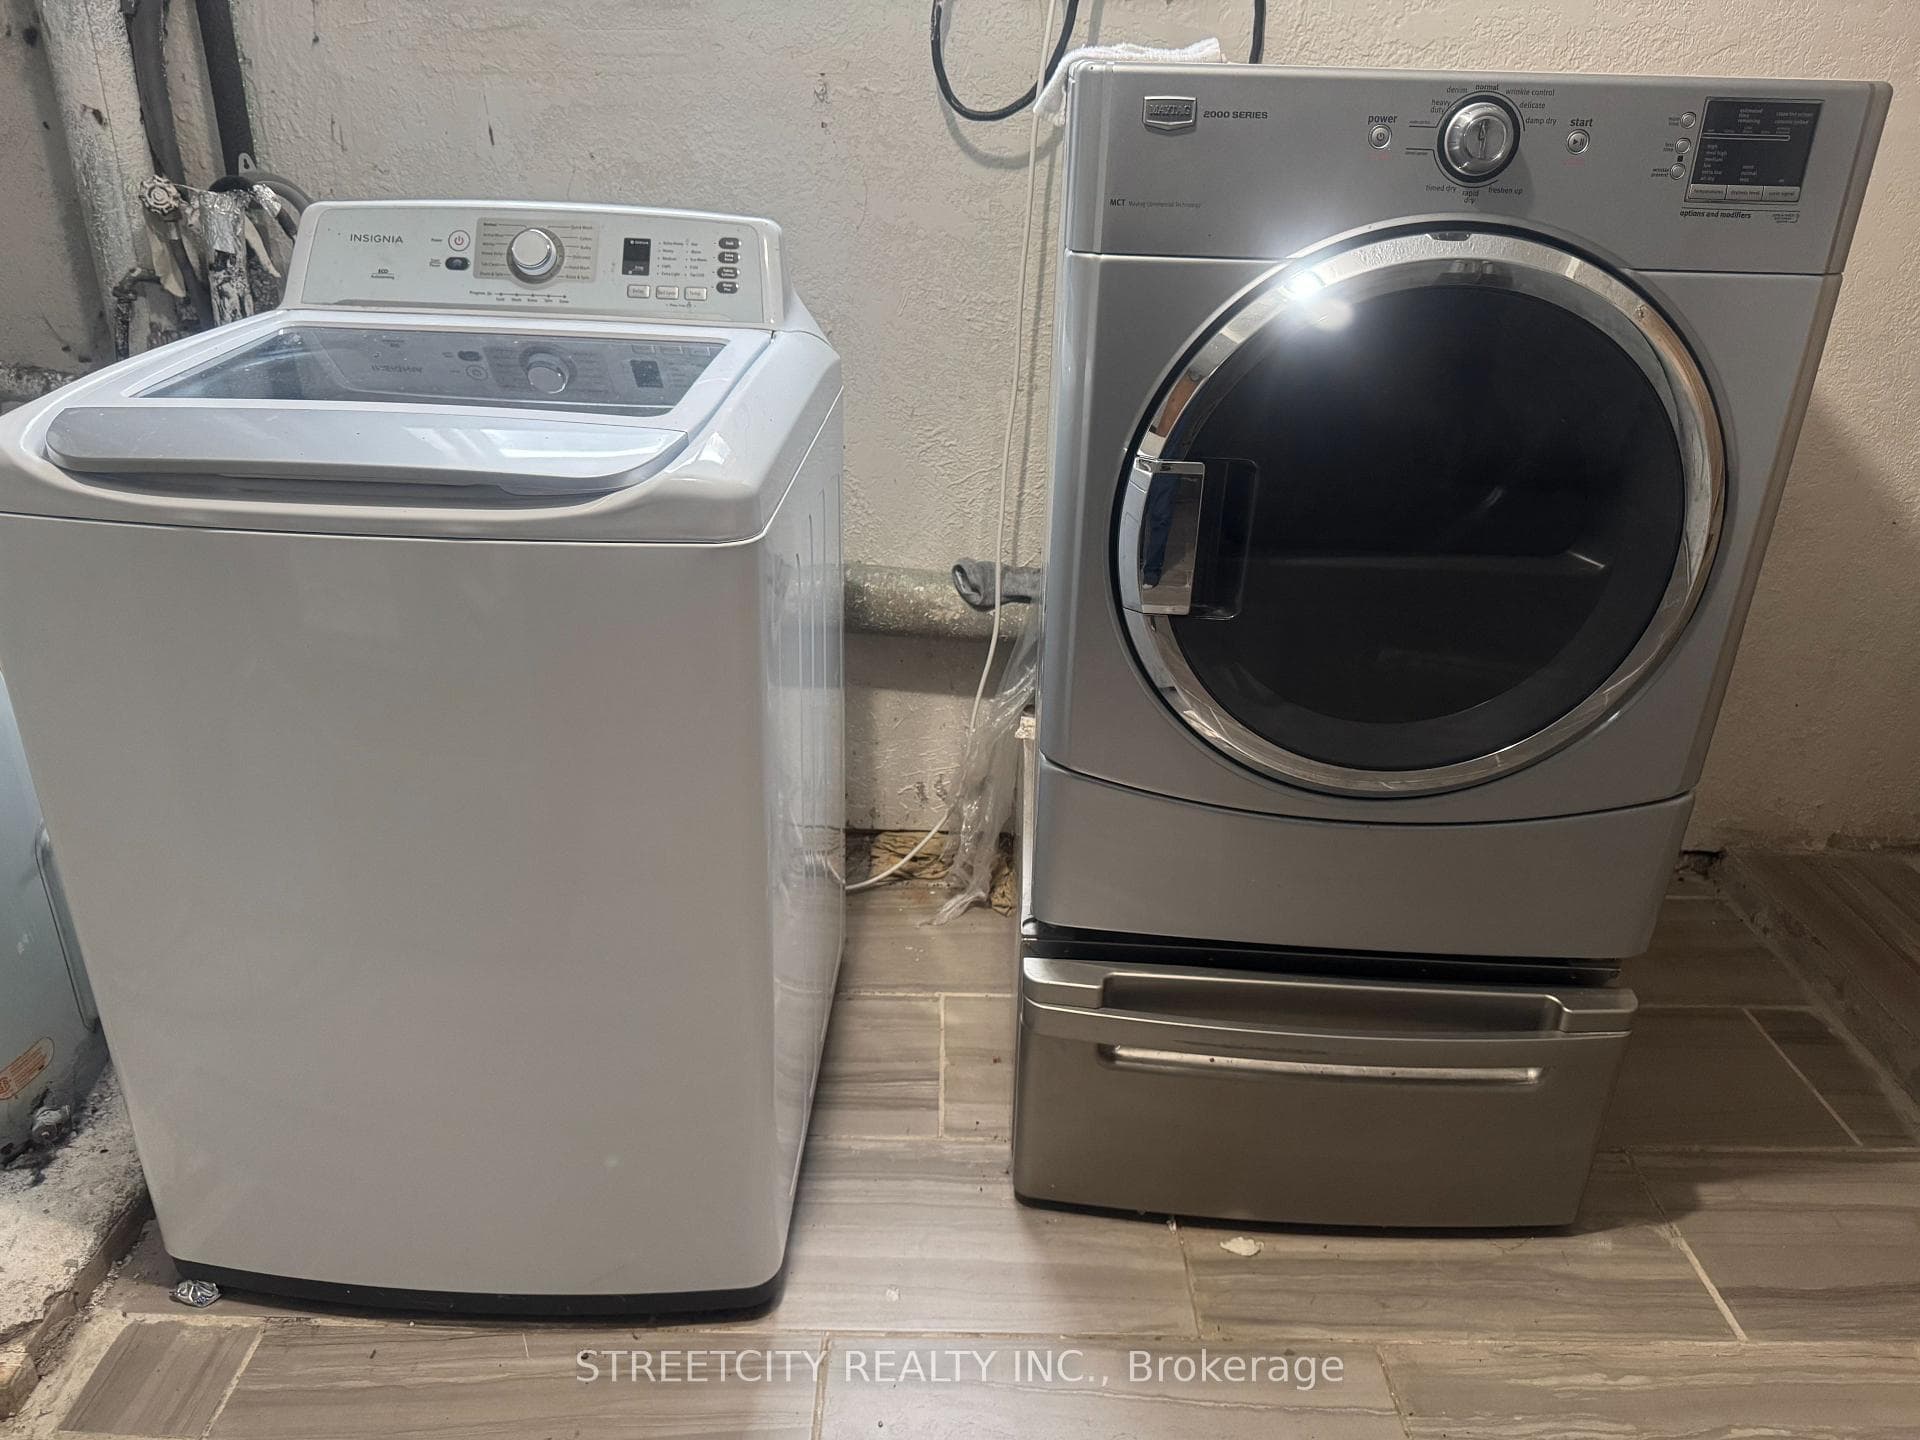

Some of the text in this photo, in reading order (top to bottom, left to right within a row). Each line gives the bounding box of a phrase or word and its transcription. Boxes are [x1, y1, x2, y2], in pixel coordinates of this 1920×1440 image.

[1531, 89, 1555, 97] control
[1431, 99, 1451, 107] heavy
[1203, 110, 1268, 119] 2000 SERIES
[1368, 115, 1398, 125] power
[1525, 116, 1557, 126] damp dry
[1570, 118, 1593, 127] start
[1462, 189, 1480, 197] rapid
[1109, 198, 1126, 207] MCT
[1680, 210, 1752, 219] options and modifiers
[350, 233, 404, 244] INSIGNIA
